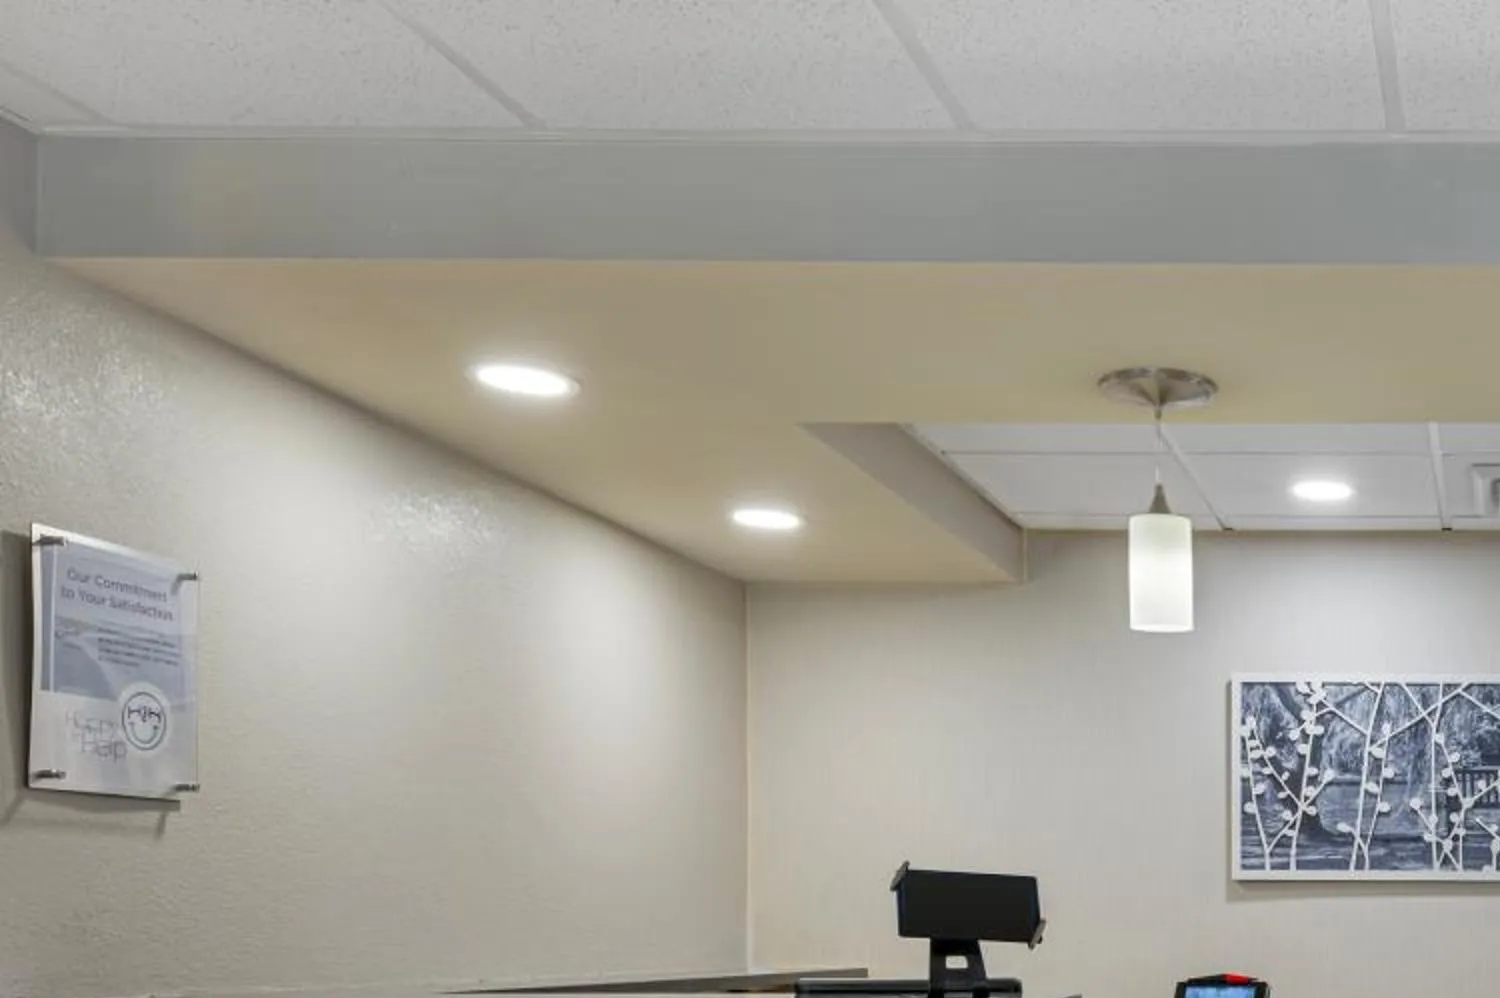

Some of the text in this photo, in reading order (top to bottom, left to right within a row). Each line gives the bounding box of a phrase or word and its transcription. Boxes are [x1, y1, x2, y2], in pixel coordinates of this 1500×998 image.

[67, 567, 167, 603] Our Commitment
[61, 585, 175, 622] to Your Satisfaction
